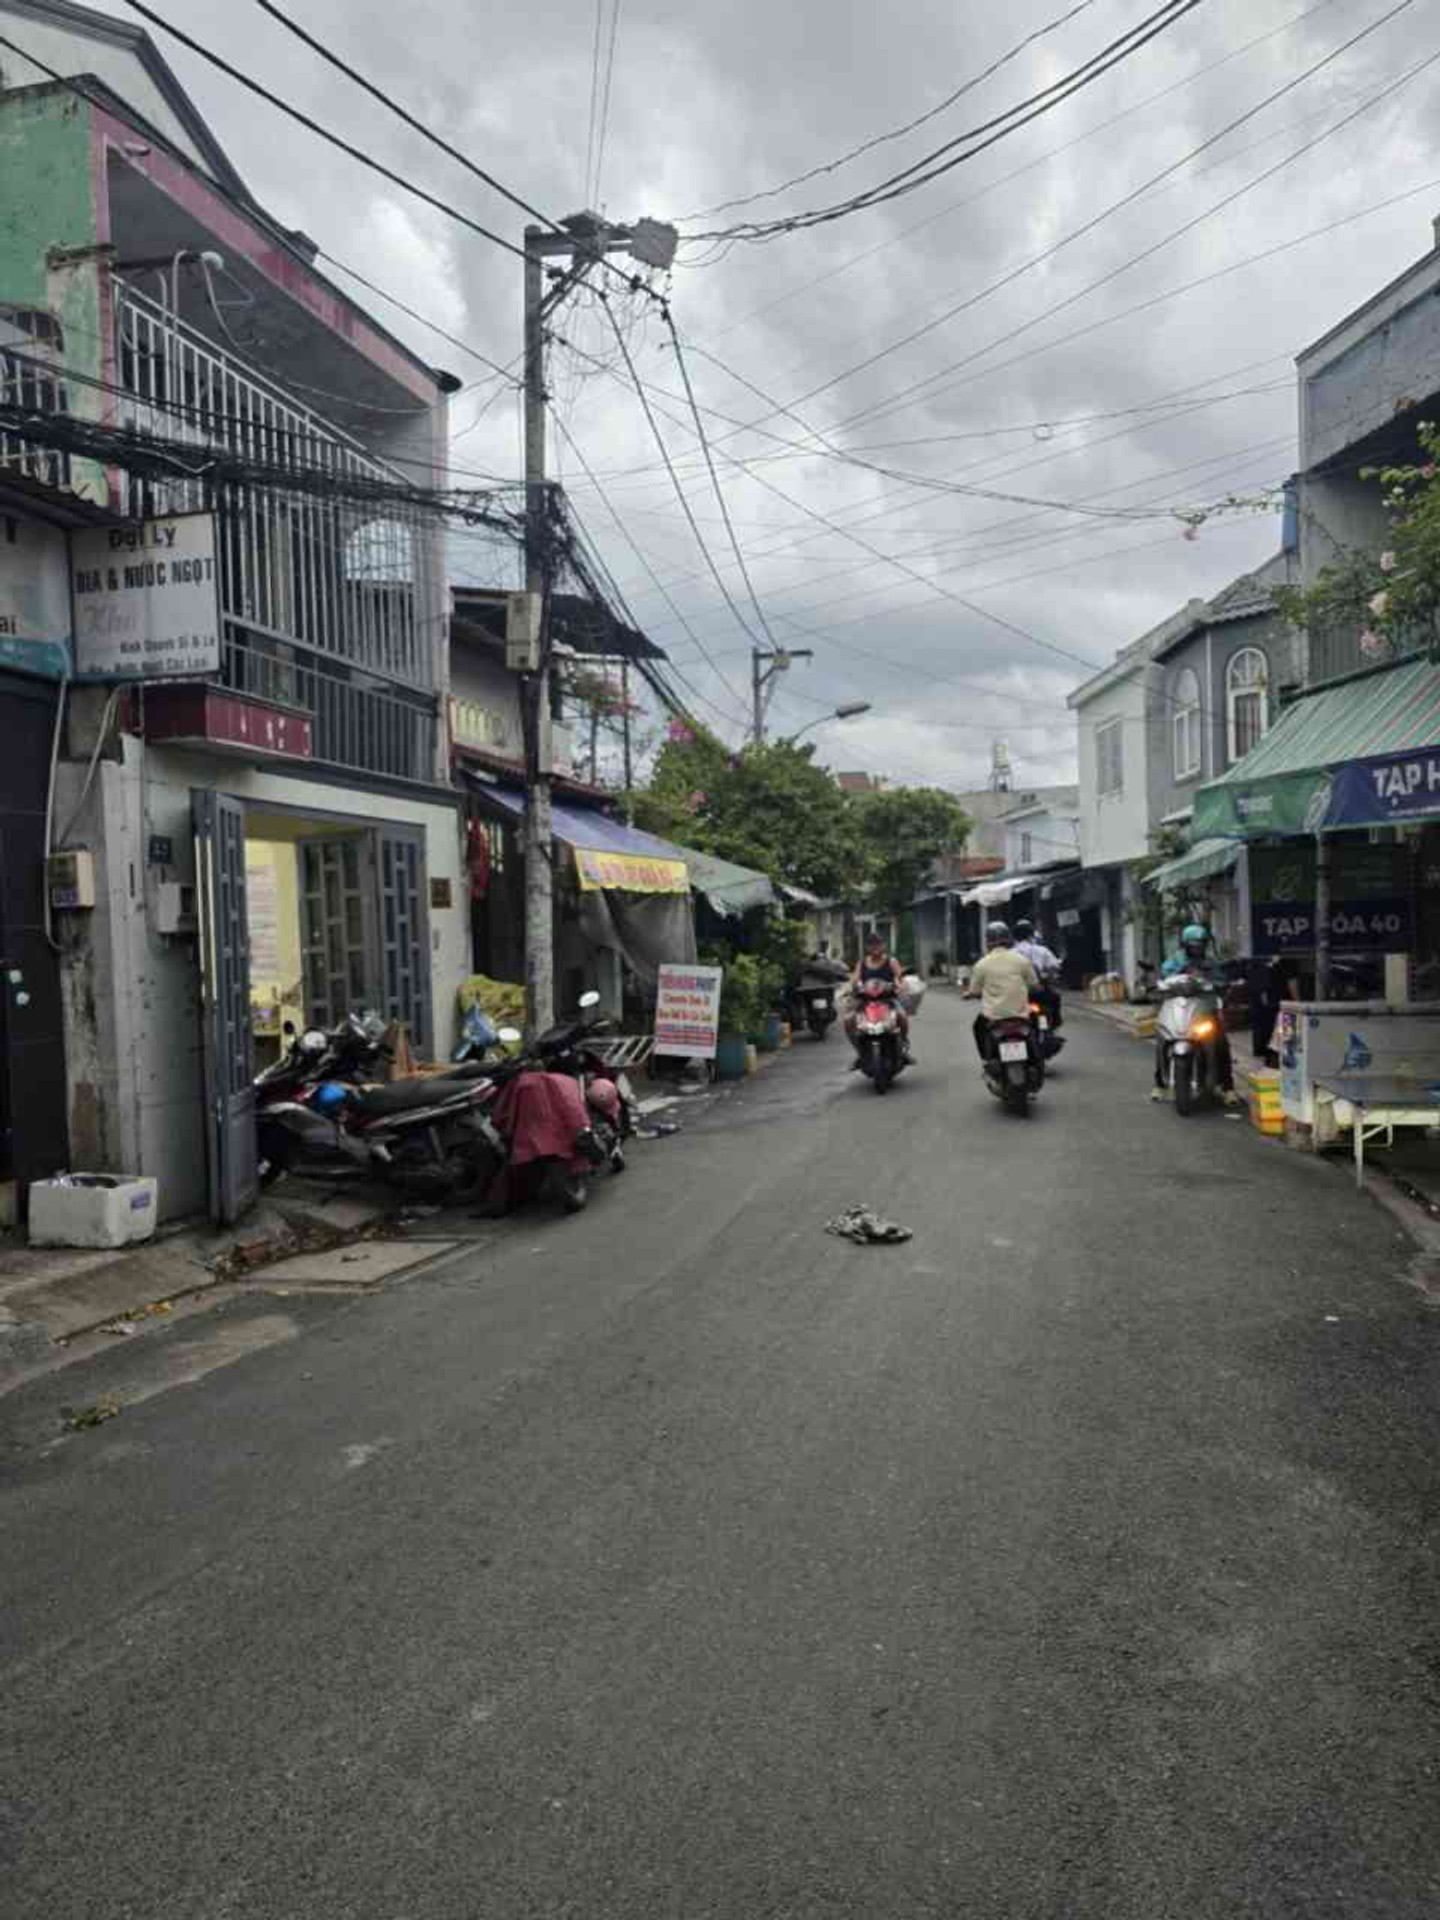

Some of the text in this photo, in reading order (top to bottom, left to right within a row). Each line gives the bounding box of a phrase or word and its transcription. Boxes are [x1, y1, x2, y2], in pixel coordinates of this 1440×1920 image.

[1372, 763, 1421, 808] TẠP
[1262, 916, 1310, 943] TẠP
[1370, 914, 1400, 933] 40
